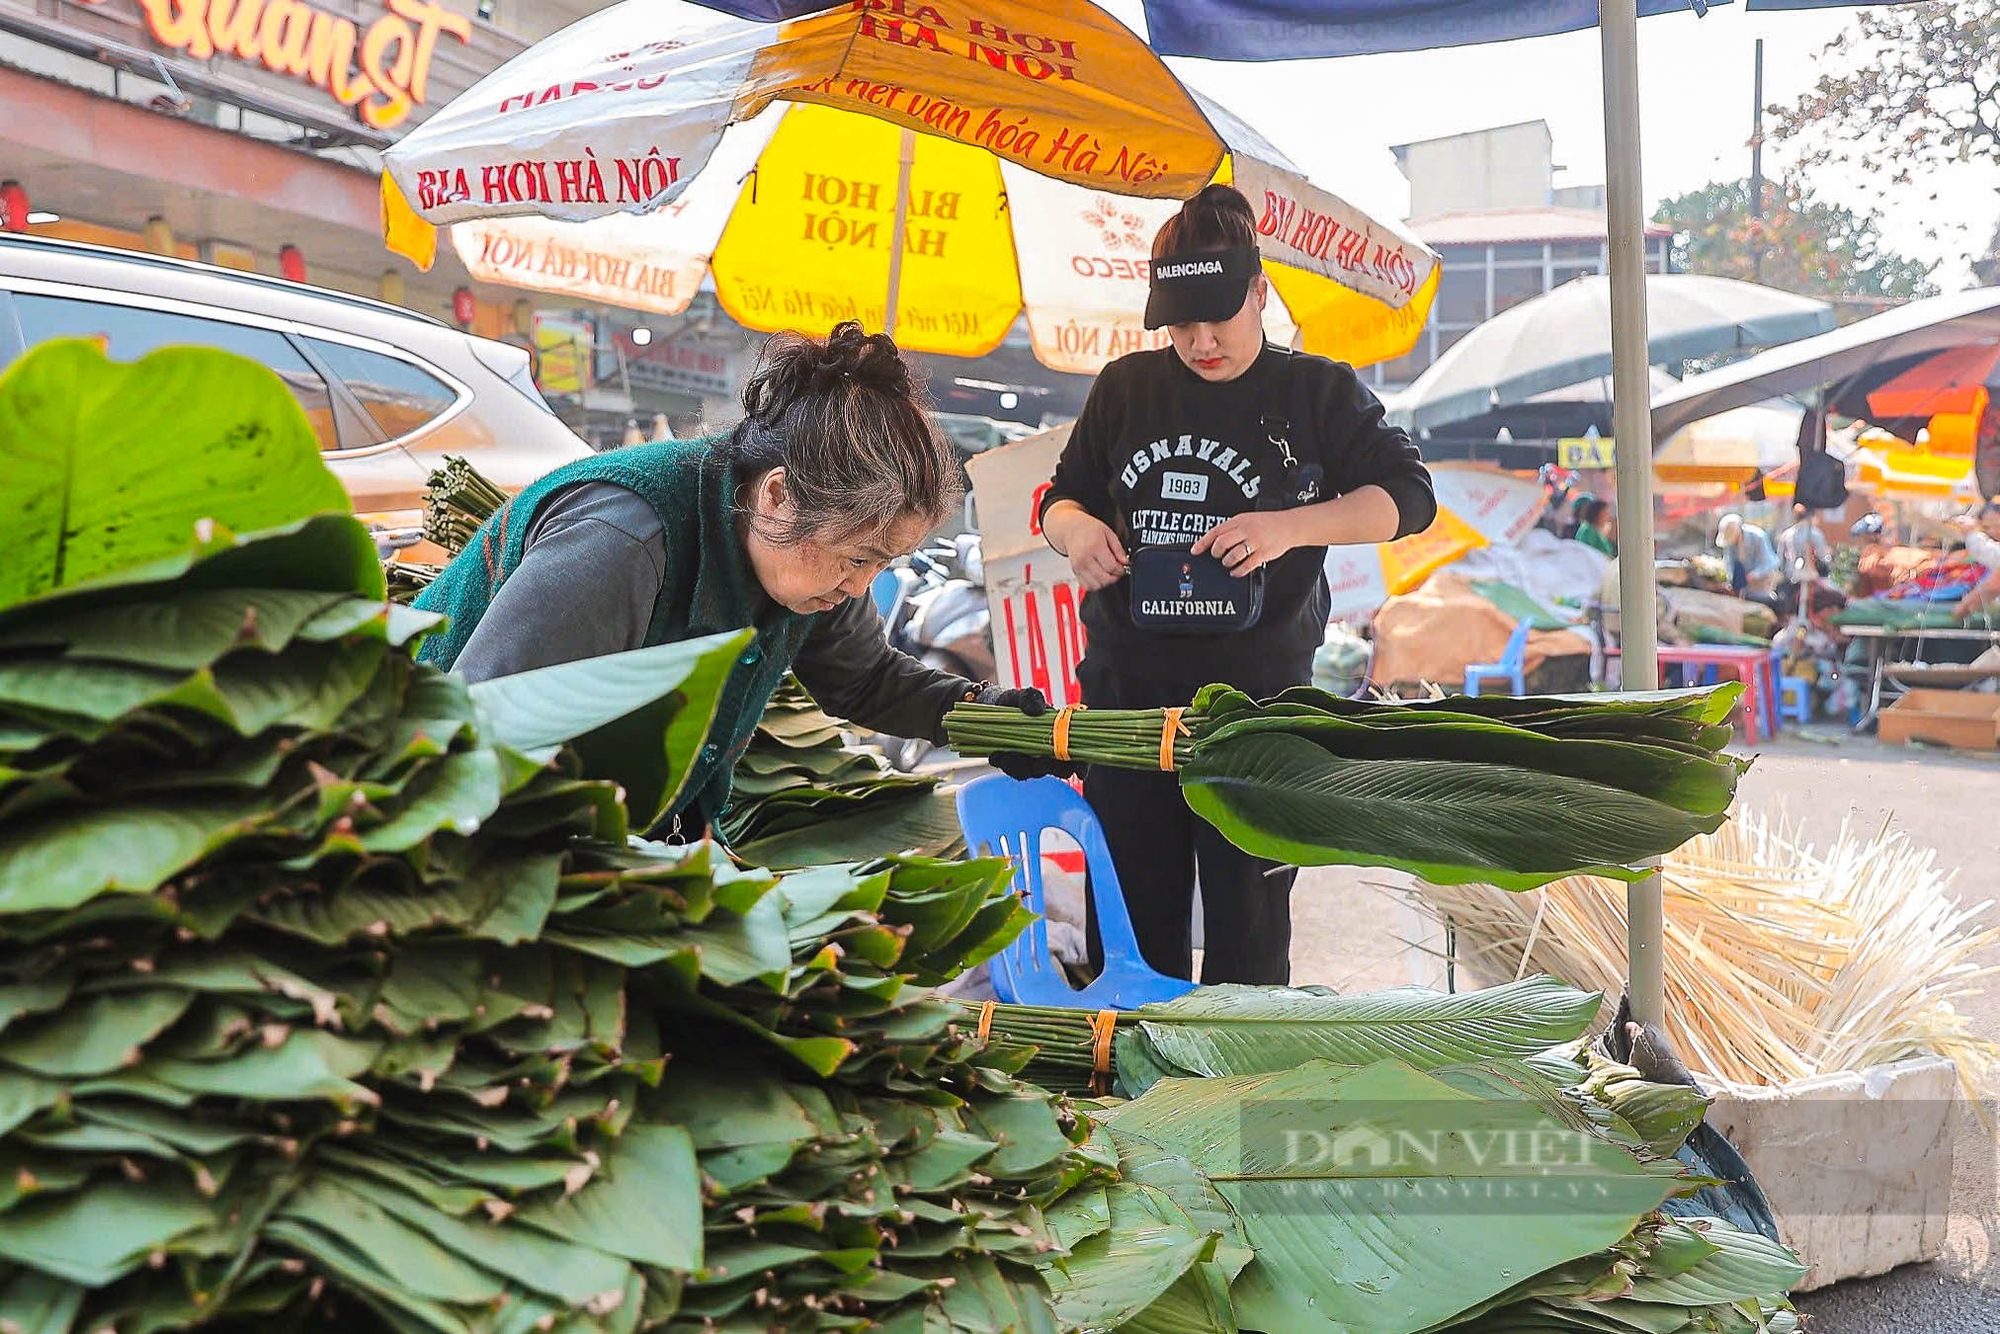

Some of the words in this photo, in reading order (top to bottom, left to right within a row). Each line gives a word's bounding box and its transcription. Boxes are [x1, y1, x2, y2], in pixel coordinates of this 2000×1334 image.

[975, 108, 1040, 159] hóa
[1043, 128, 1101, 175] Hà
[417, 167, 471, 210] BIA
[481, 160, 554, 203] HƠI
[553, 146, 609, 204] HÀ
[1157, 260, 1223, 280] BALENCIAGA
[1168, 477, 1200, 495] 1983
[1132, 509, 1182, 531] LITTLE
[1140, 529, 1176, 545] HAWKINS
[1142, 600, 1236, 616] CALIFORNIA
